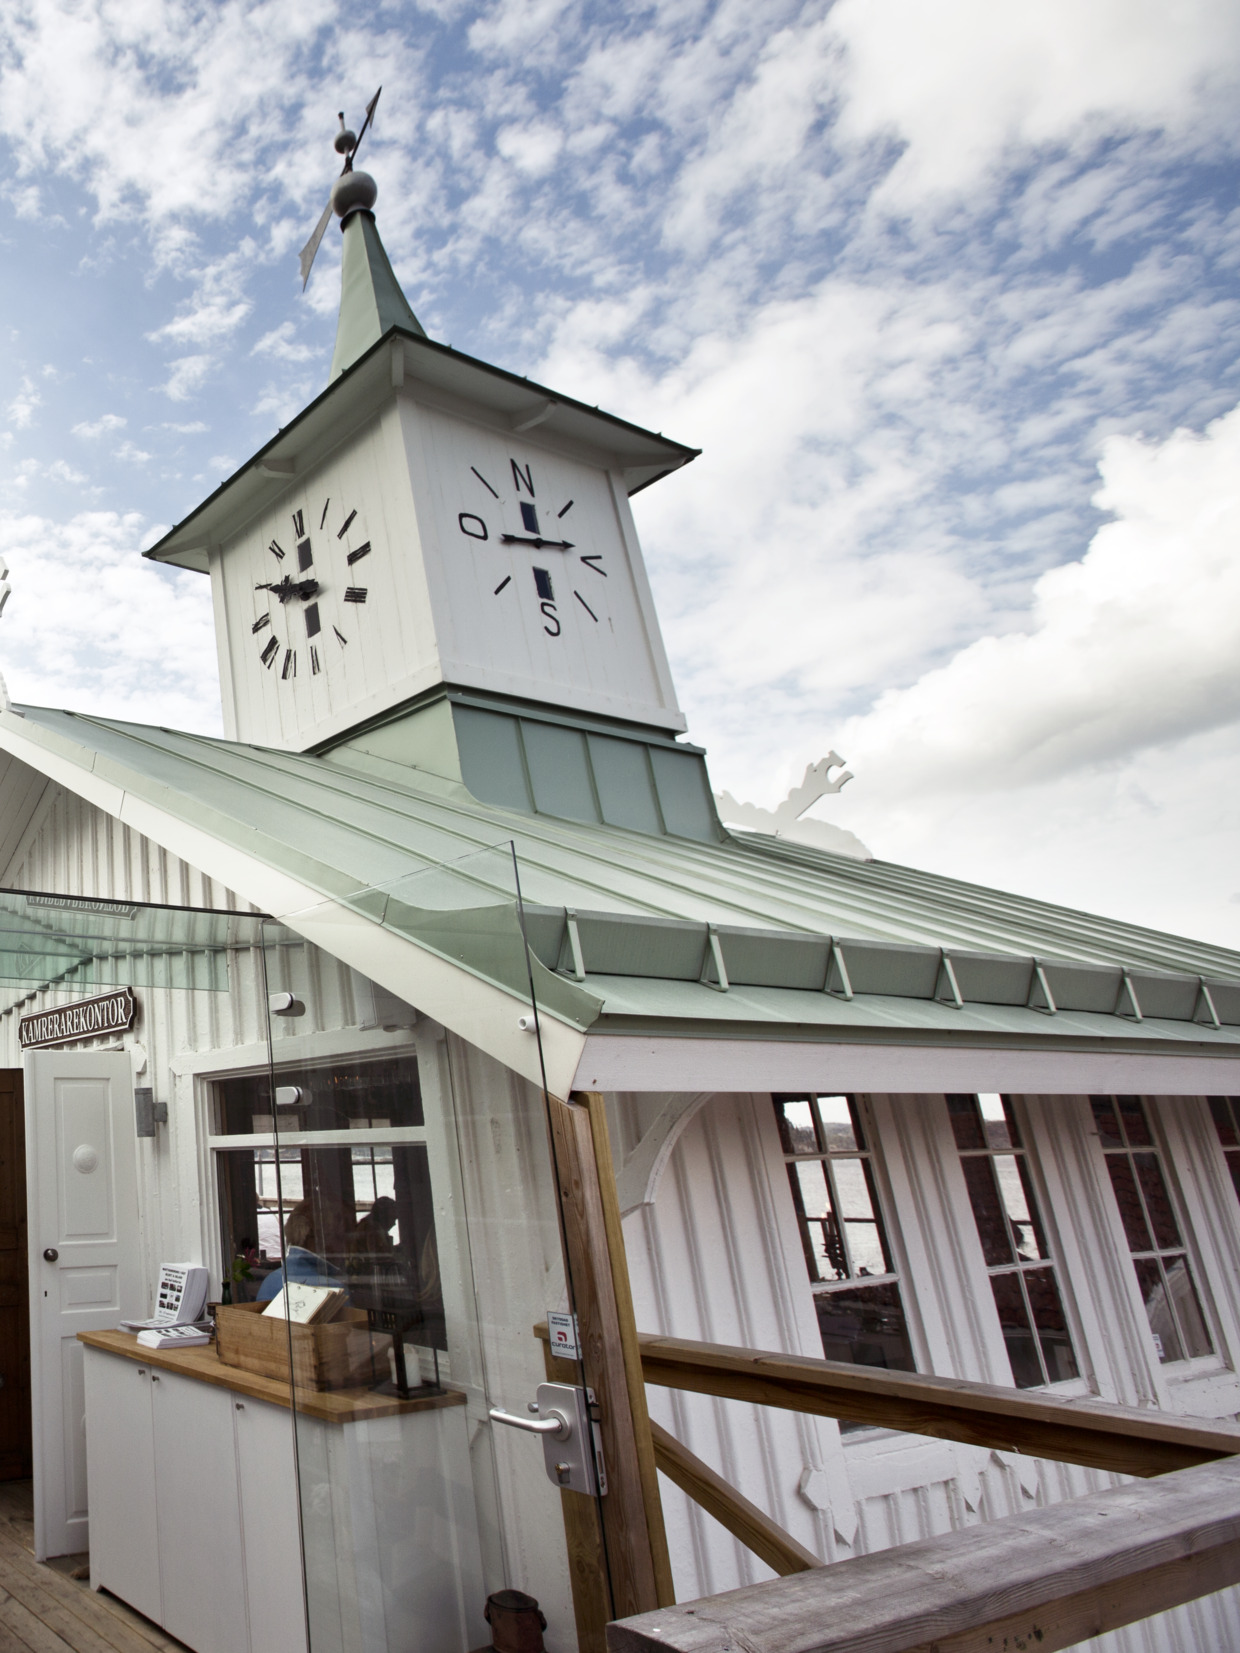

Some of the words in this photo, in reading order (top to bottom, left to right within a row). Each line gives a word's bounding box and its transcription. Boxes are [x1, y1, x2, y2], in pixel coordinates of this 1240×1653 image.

[510, 458, 535, 498] N
[540, 601, 561, 637] S
[21, 997, 127, 1045] KAMRERAREKONTOR
